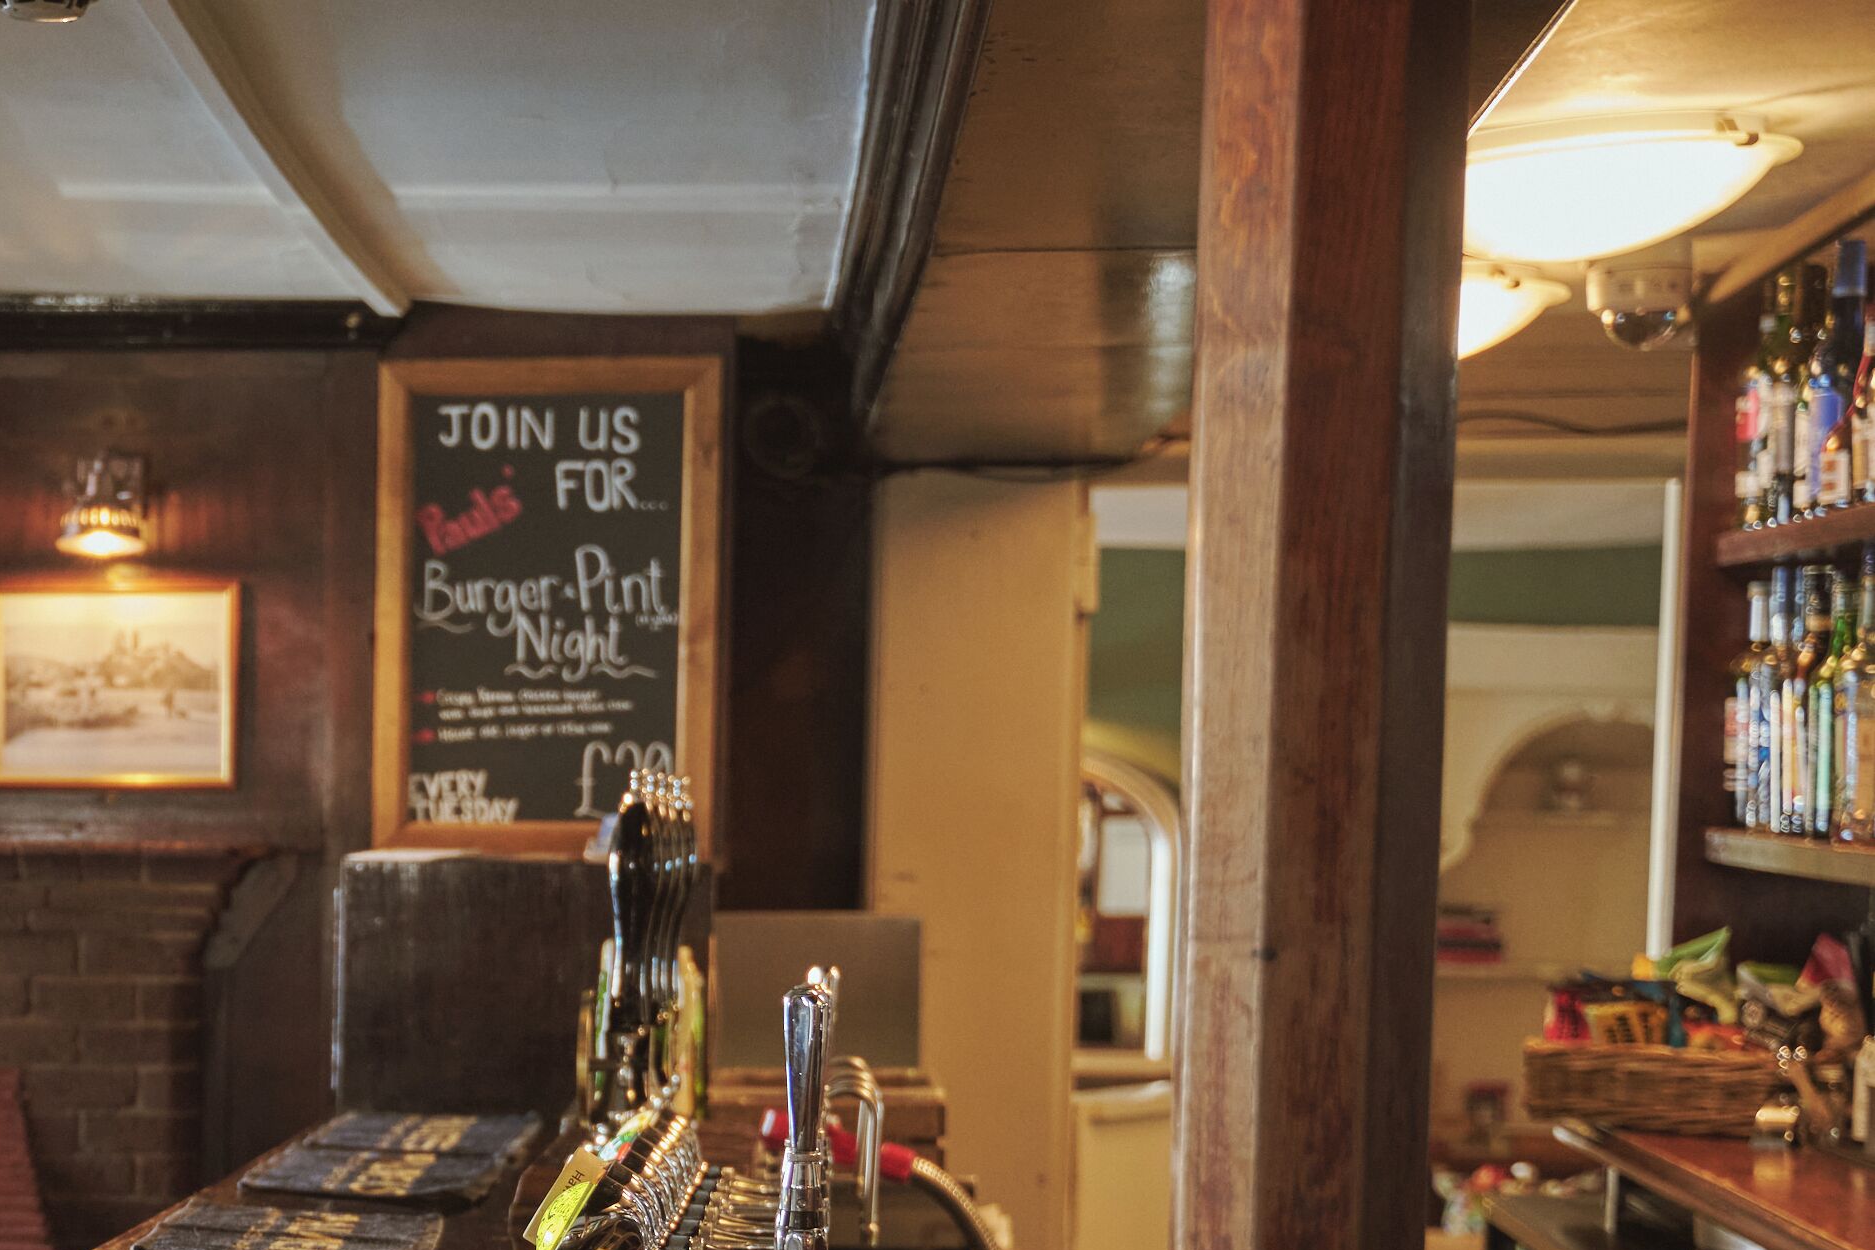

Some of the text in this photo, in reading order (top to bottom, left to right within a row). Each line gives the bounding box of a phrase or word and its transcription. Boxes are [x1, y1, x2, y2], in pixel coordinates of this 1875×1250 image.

[437, 402, 642, 454] JOIN US
[516, 612, 630, 682] Night
[409, 769, 489, 801] EVERY
[409, 797, 520, 826] TUESDAY
